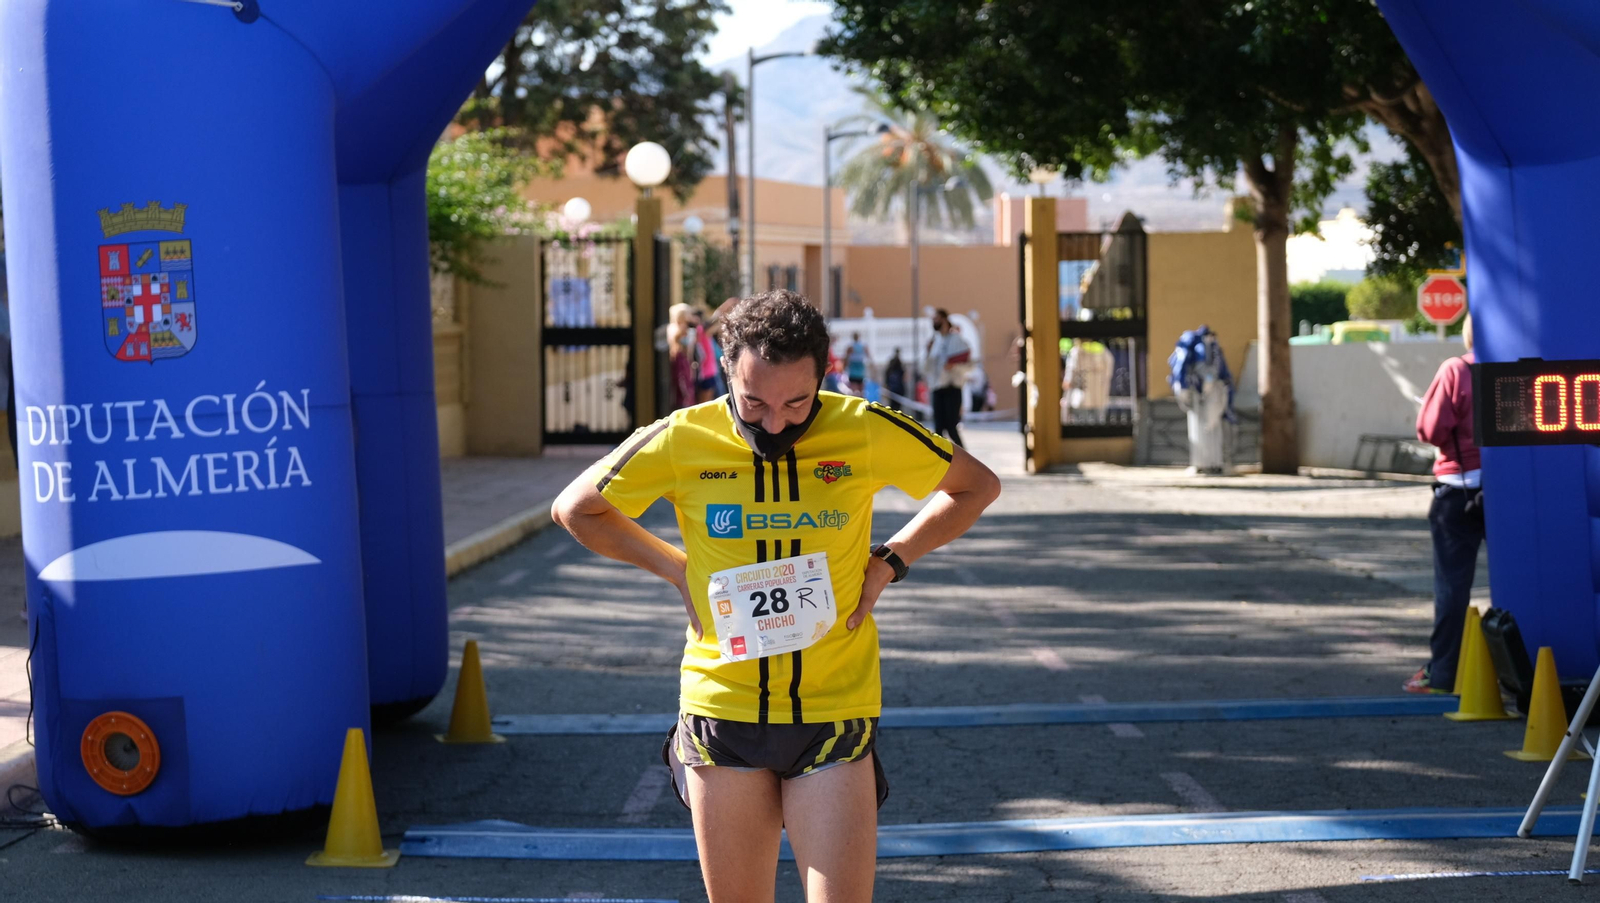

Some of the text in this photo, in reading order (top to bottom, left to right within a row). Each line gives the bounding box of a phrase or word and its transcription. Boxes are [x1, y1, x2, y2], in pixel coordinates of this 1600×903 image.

[1422, 292, 1464, 308] STOP
[26, 380, 311, 446] DIPUTACIÓN
[32, 436, 312, 503] DE ALMERÍA
[735, 563, 795, 584] CIRCUITO 2020
[737, 575, 797, 593] CARRERAS POPULARES
[749, 587, 790, 618] 28
[795, 587, 818, 609] R
[757, 613, 796, 632] CHICHO
